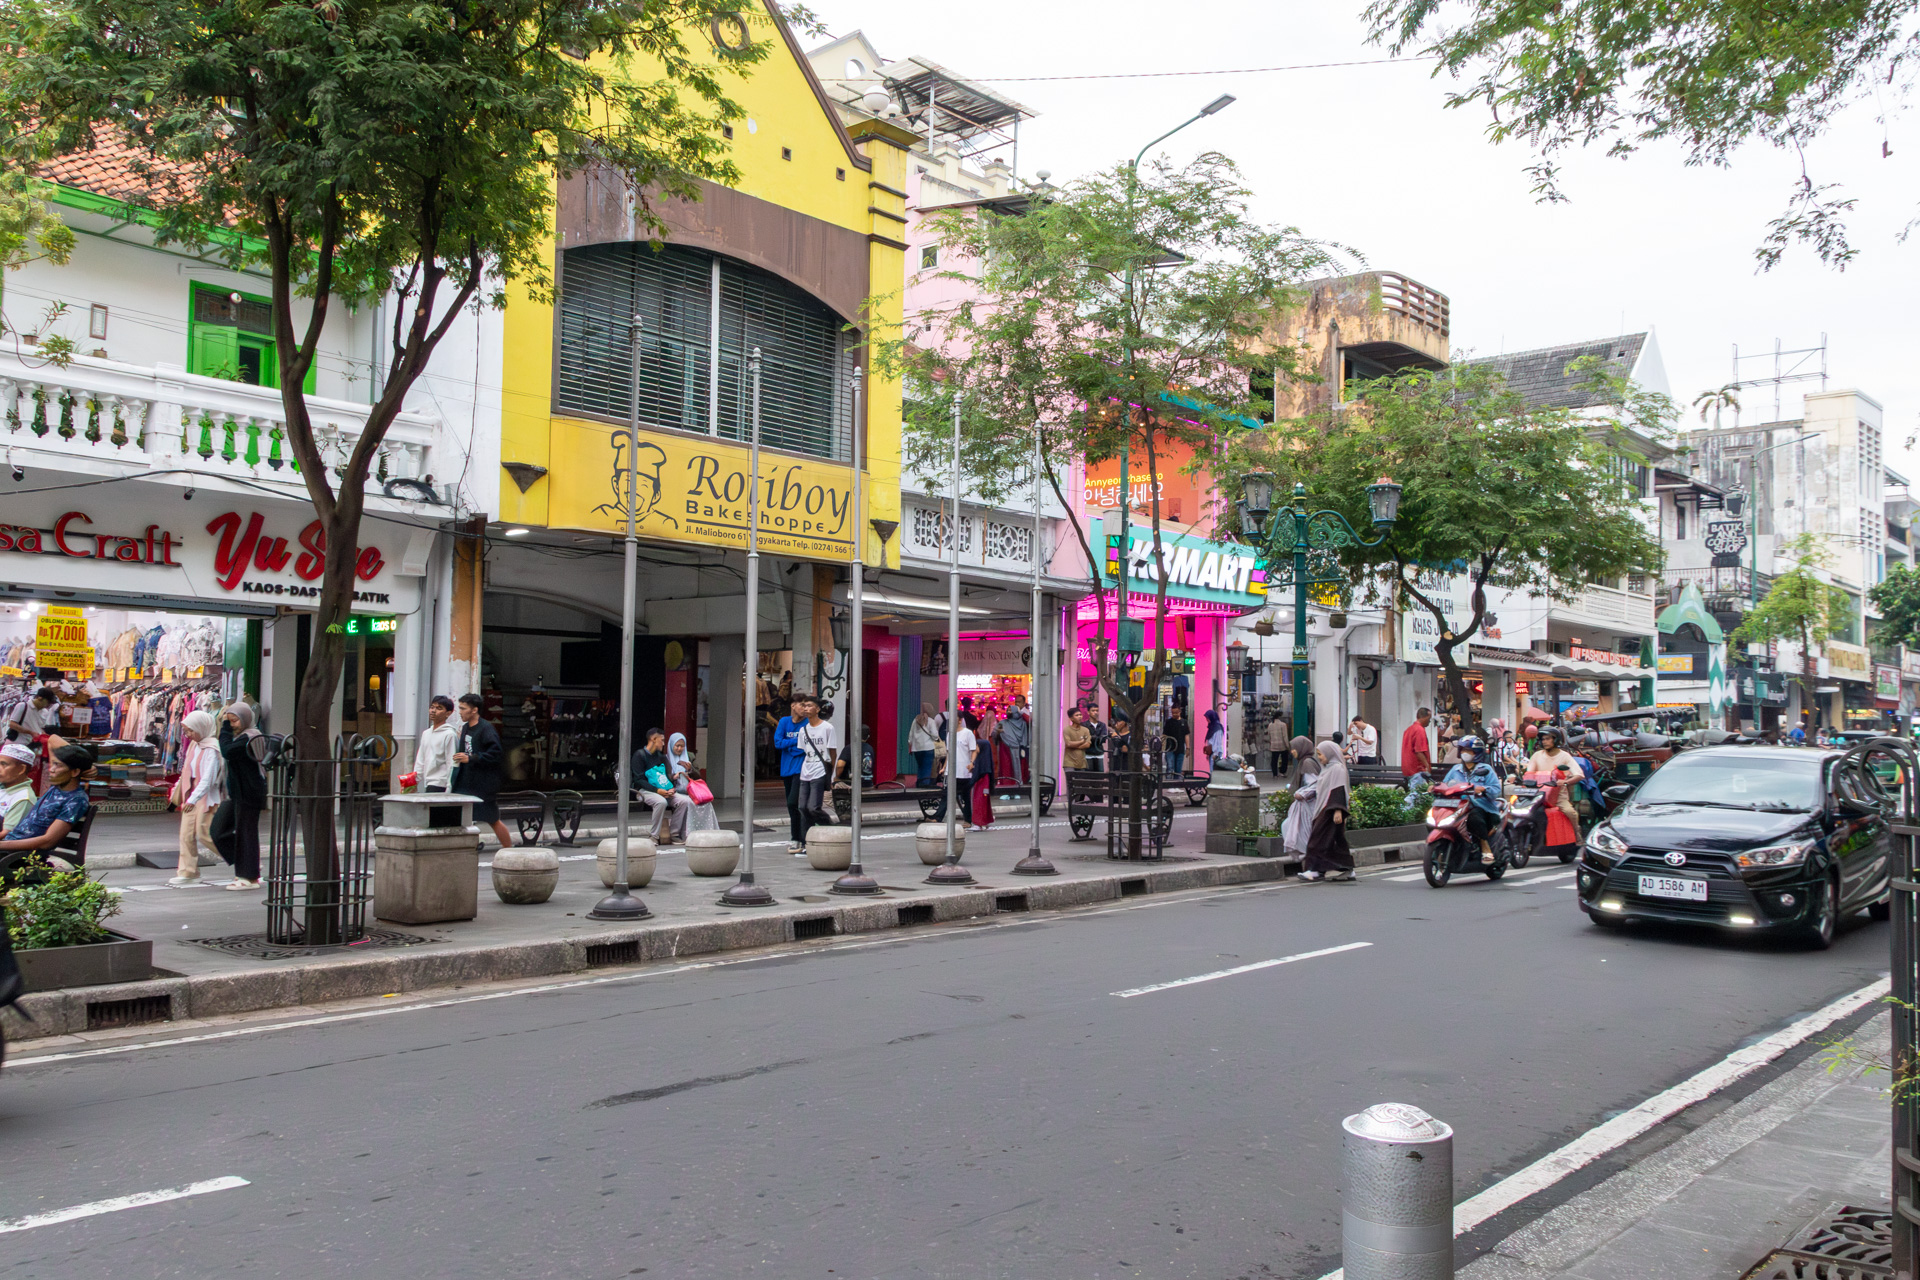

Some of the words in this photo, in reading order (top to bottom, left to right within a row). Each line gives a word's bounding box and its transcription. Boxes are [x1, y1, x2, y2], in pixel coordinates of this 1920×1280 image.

[1711, 523, 1742, 532] BATIK
[1716, 530, 1738, 539] AND
[54, 511, 182, 567] Craft
[685, 525, 694, 534] Jl.
[695, 526, 736, 539] Malioboro
[738, 533, 747, 541] 61
[793, 539, 810, 551] Telp.
[811, 542, 833, 553] (0274)
[834, 545, 847, 554] 566
[1707, 536, 1746, 547] COFFEE
[205, 511, 292, 591] Yu
[295, 519, 386, 581] Se
[1714, 545, 1741, 554] SHOP
[1412, 617, 1432, 635] KHAS
[1434, 619, 1459, 636] JJA
[1641, 877, 1654, 889] AD
[1659, 879, 1685, 892] 1586
[1690, 882, 1704, 894] AM
